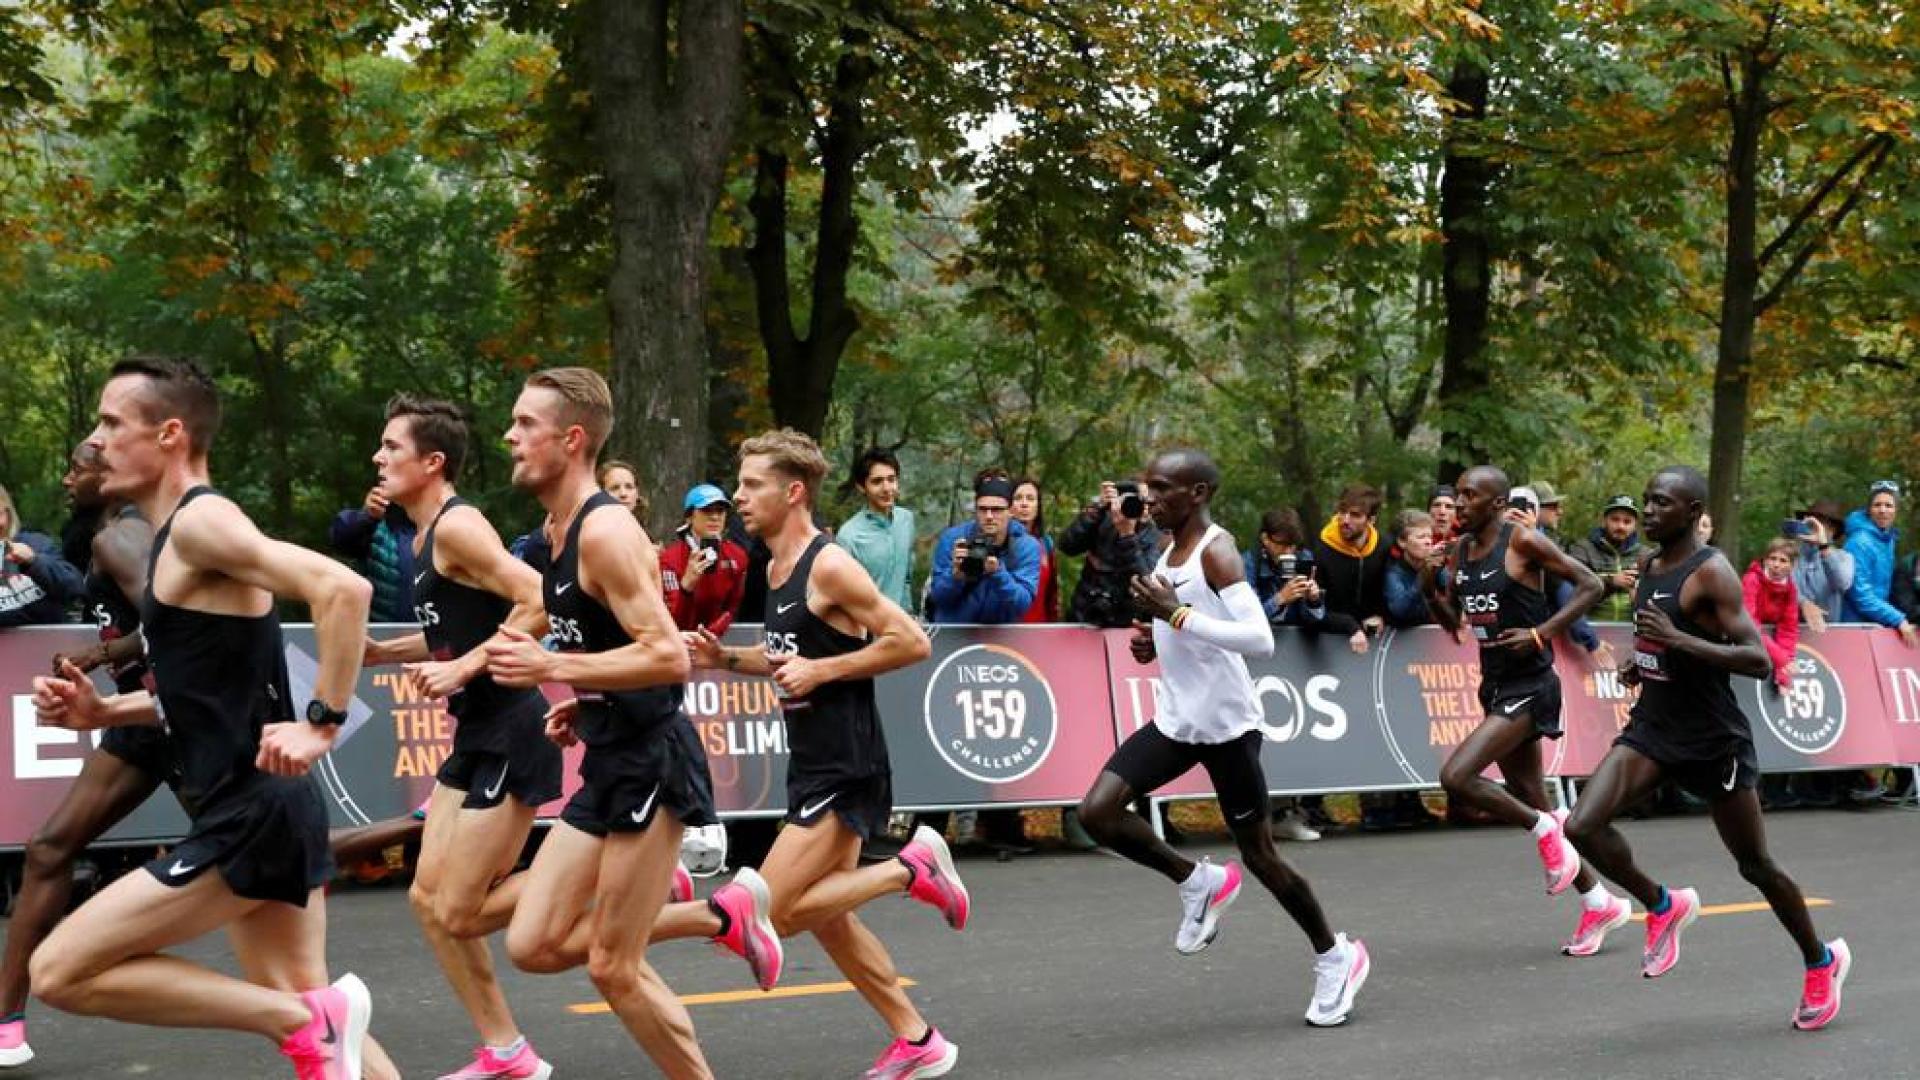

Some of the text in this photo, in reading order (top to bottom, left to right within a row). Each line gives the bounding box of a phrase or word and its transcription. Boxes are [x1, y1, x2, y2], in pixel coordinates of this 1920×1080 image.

[957, 664, 1019, 683] INEOS
[955, 689, 1026, 739] 1:59
[1421, 691, 1461, 717] THE
[391, 709, 451, 740] THE
[951, 736, 1040, 769] CHALLENGE
